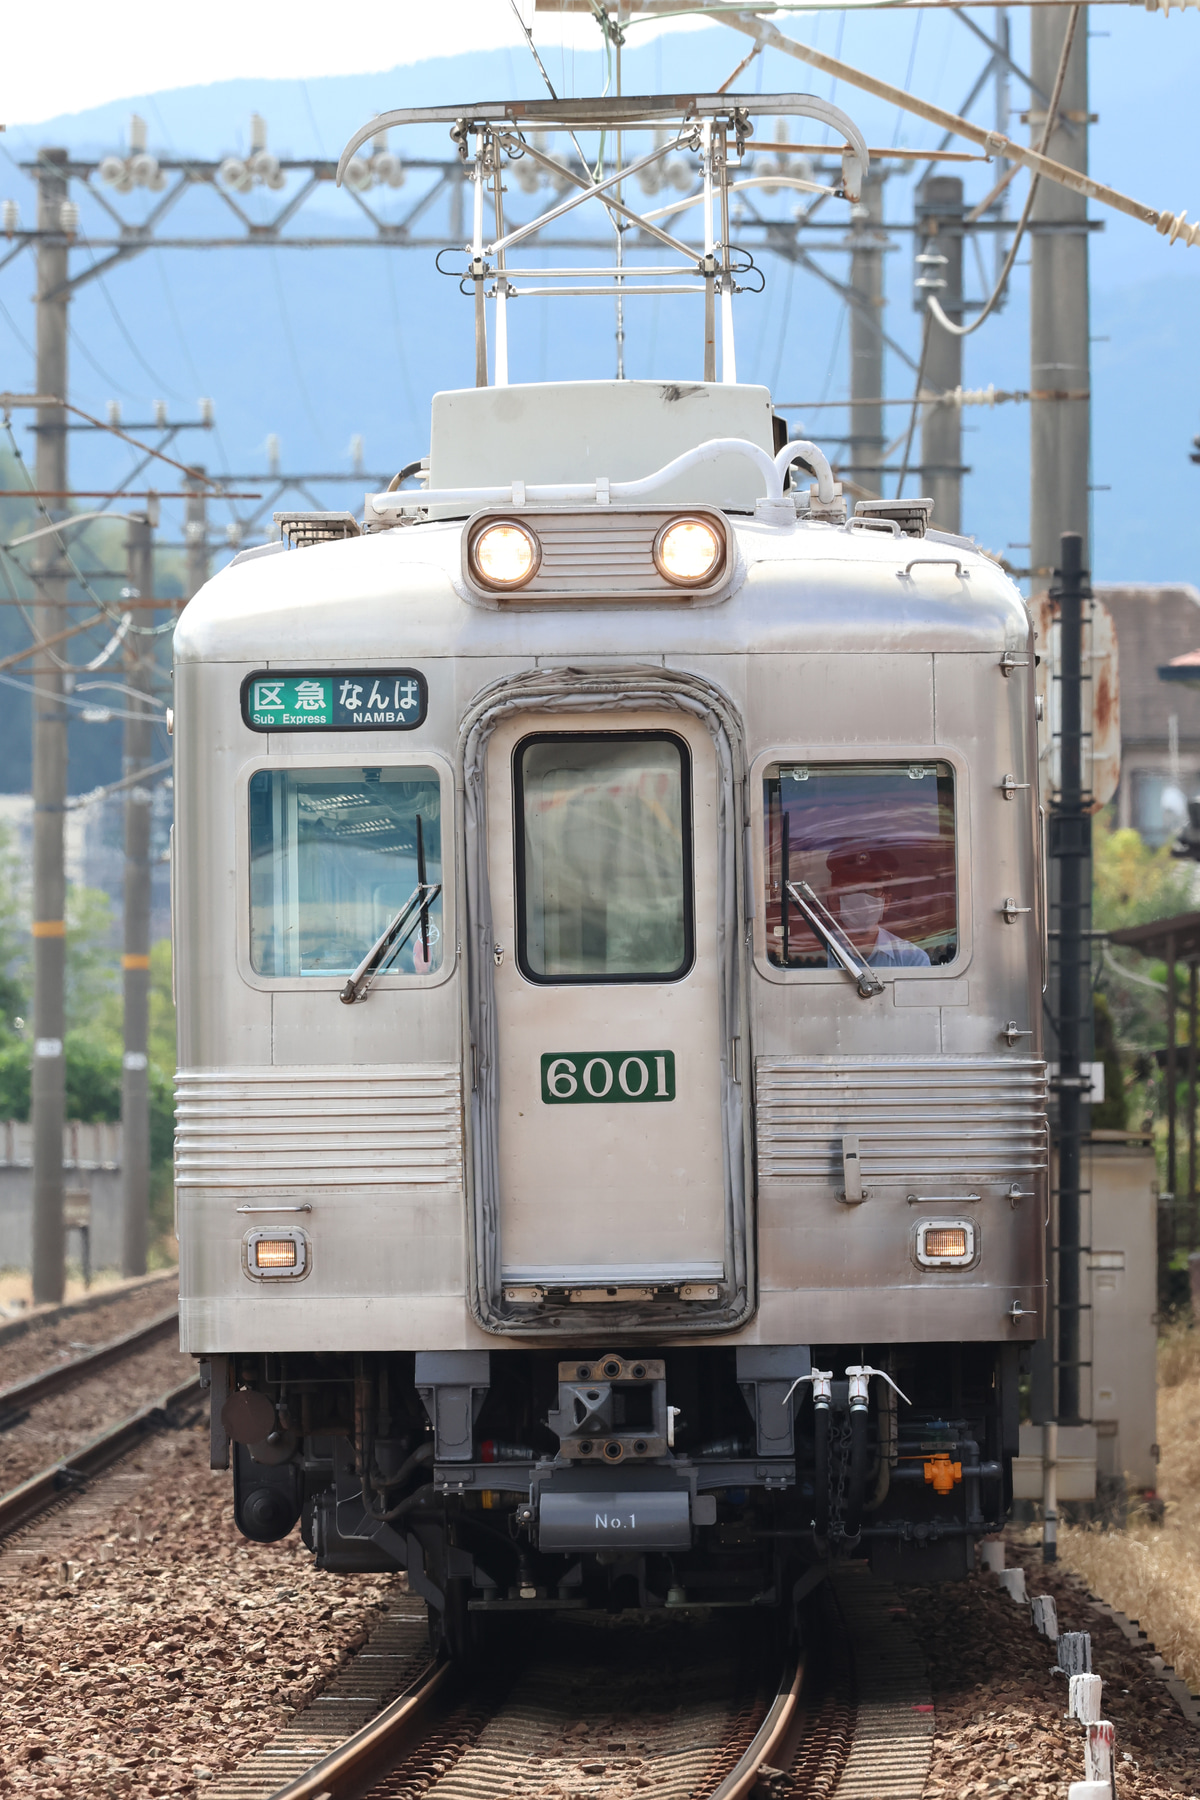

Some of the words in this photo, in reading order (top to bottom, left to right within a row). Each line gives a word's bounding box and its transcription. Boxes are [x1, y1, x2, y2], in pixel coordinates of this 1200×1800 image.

[254, 681, 327, 711] 区急
[339, 680, 418, 710] なんば
[253, 714, 275, 724] Sub
[282, 714, 327, 725] Express
[353, 712, 406, 723] NAMBA
[546, 1056, 670, 1098] 6001
[595, 1513, 636, 1529] No.1
